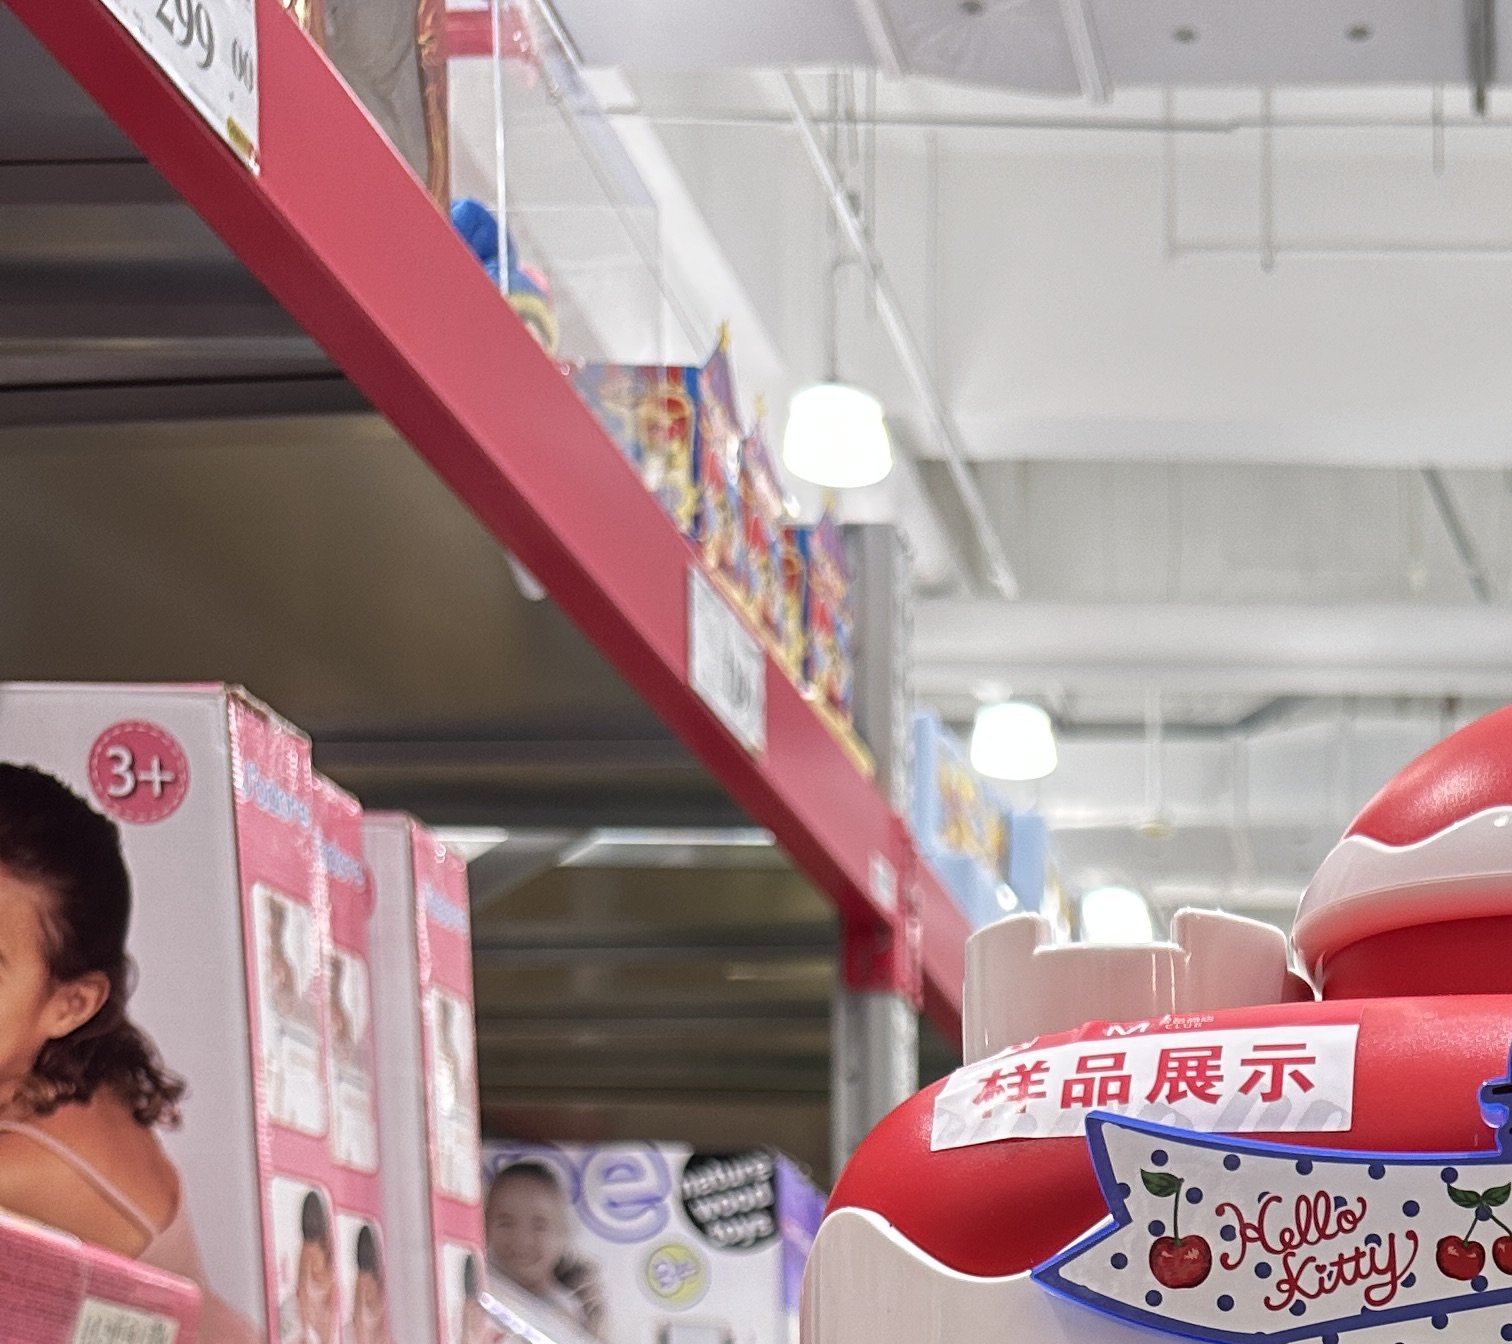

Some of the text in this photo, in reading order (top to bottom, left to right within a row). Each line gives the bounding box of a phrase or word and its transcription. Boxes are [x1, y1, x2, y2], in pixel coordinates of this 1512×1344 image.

[106, 744, 176, 799] 3+
[971, 1041, 1317, 1119] 样品展示
[1216, 1190, 1367, 1271] Hello
[1264, 1230, 1419, 1311] Kitty
